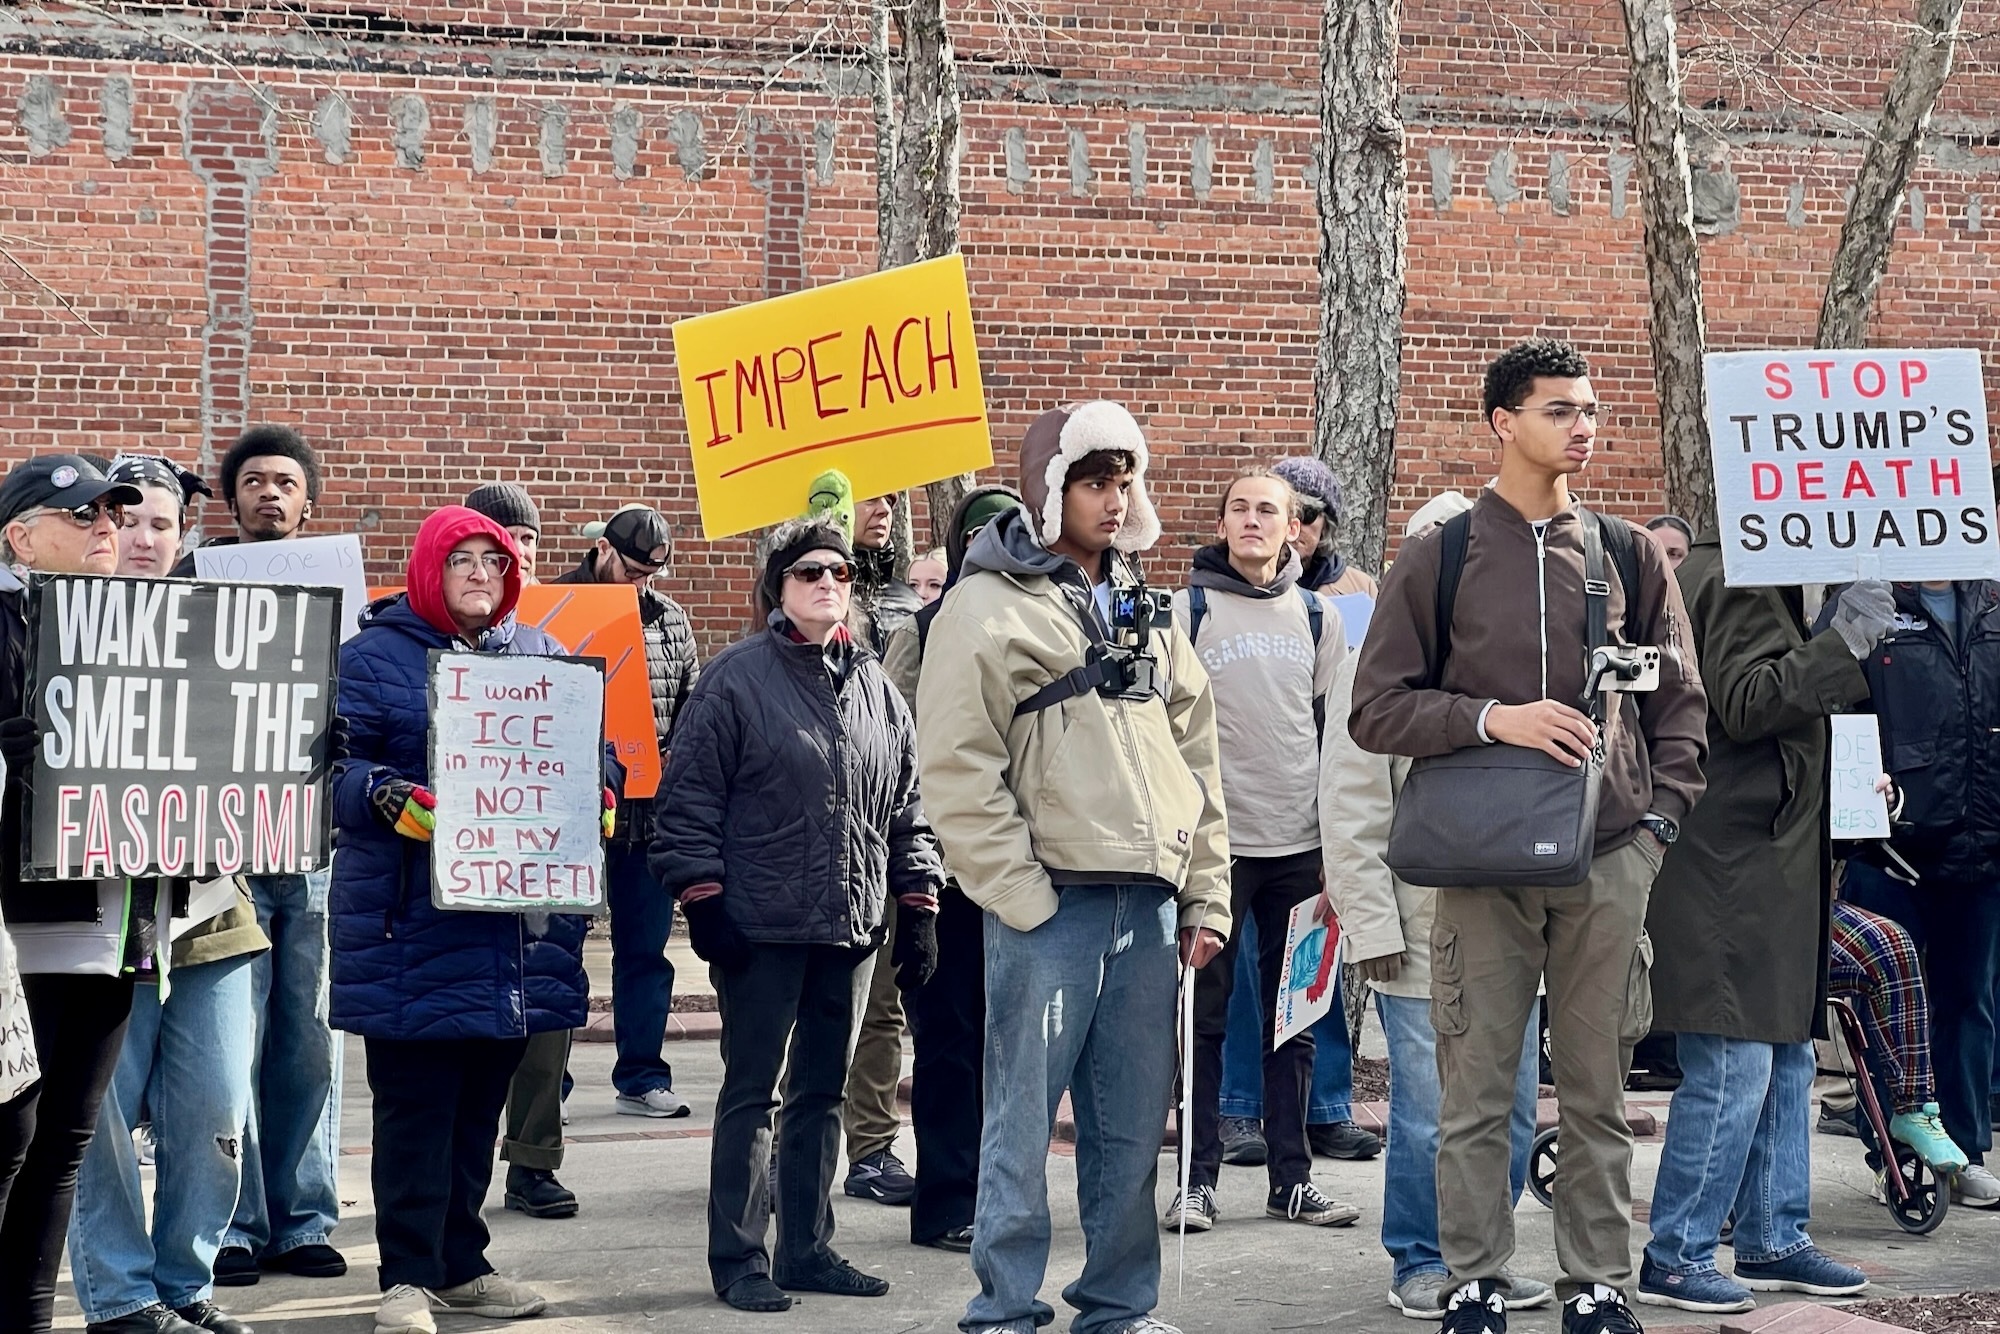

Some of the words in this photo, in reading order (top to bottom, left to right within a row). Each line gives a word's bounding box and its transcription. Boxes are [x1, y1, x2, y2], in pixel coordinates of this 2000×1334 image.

[695, 310, 958, 448] IMPEACH
[1763, 360, 1929, 400] STOP
[1729, 405, 1975, 453] TRUMP'S
[1751, 458, 1962, 501] DEATH
[1739, 506, 1989, 551] SQUADS
[55, 579, 193, 668] WAKE
[447, 667, 471, 701] I
[485, 674, 554, 702] want
[42, 674, 197, 771] SMELL
[230, 681, 319, 773] THE
[472, 711, 554, 749] ICE
[445, 752, 468, 771] in
[480, 755, 512, 782] my
[515, 751, 565, 777] tea
[475, 785, 552, 818] NOT
[56, 783, 316, 880] FASCISM!
[456, 827, 495, 851] ON
[515, 827, 561, 851] MY
[448, 859, 596, 902] STREET!
